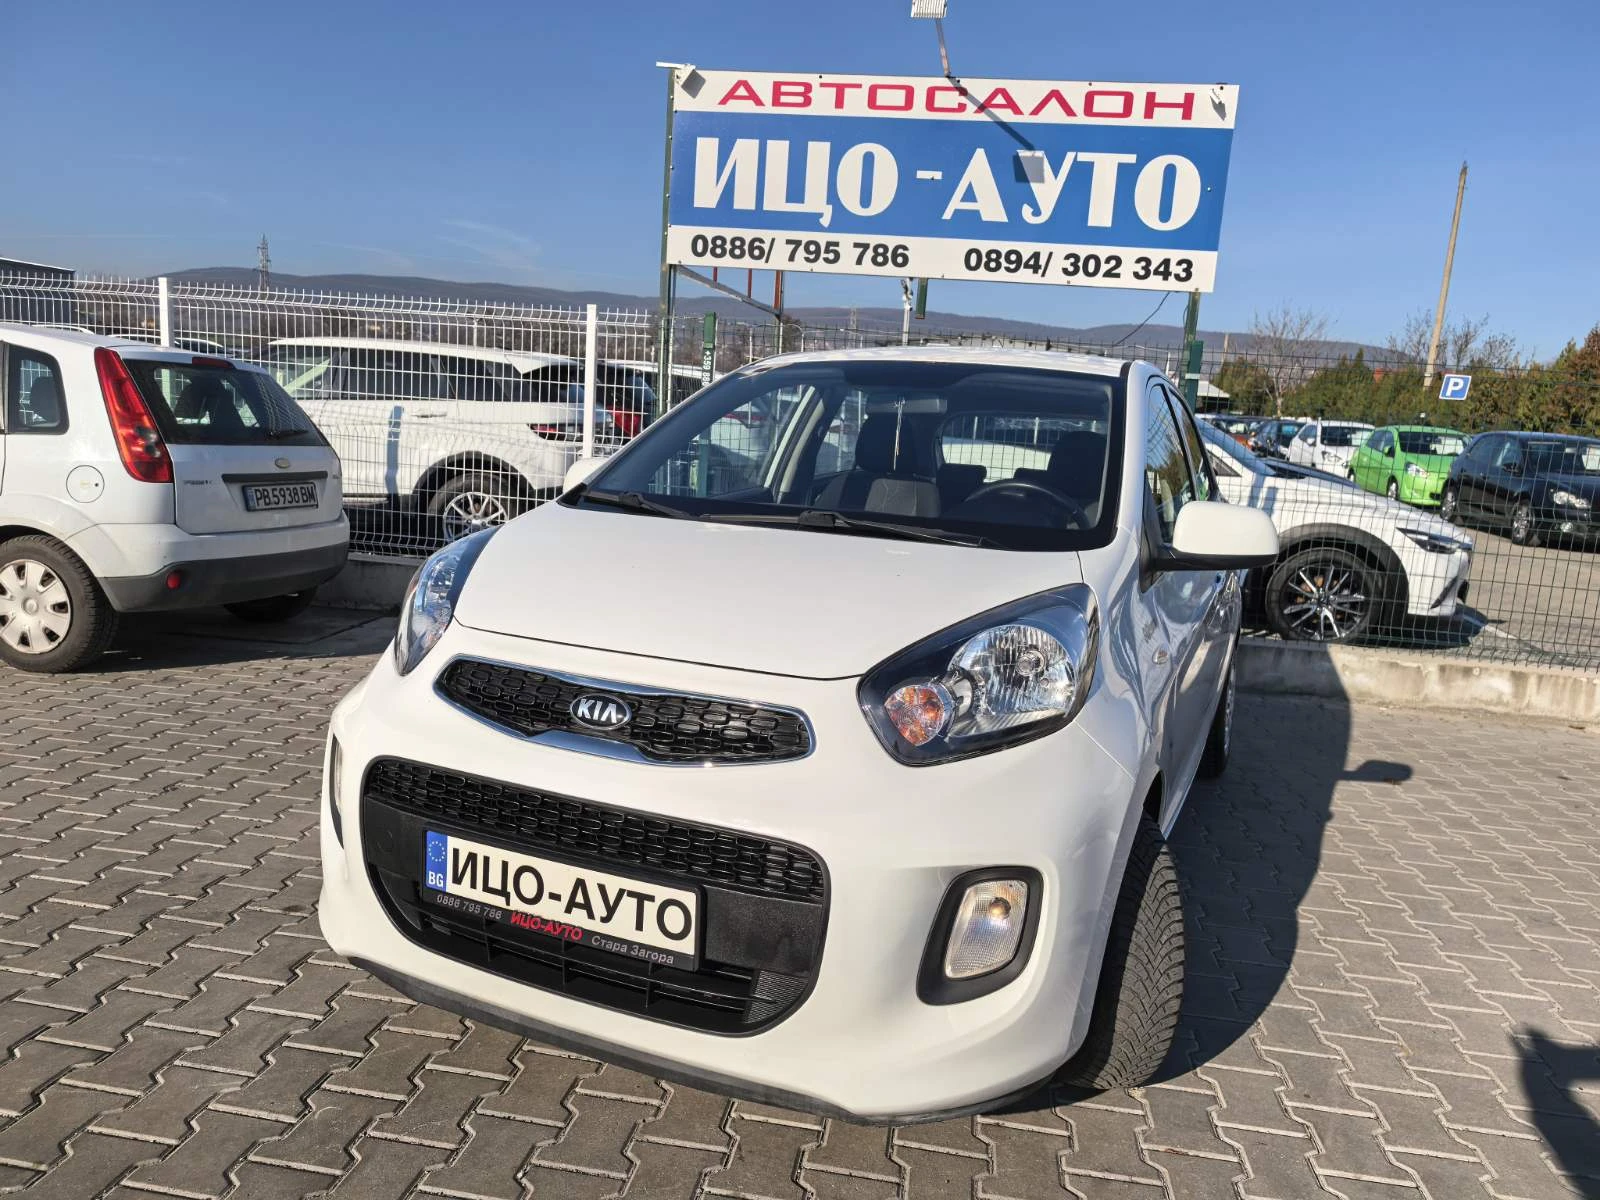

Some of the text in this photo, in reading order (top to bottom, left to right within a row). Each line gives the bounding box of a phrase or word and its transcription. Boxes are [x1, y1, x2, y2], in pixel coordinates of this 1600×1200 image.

[719, 79, 1195, 121] АВТОСАЛОН
[691, 234, 910, 268] 0886/ 795 786
[964, 247, 1195, 283] 0894/ 302 343
[1445, 377, 1464, 397] P
[577, 698, 618, 724] KIA
[428, 870, 444, 888] BG
[451, 847, 692, 941] ИЦО-АУТО
[436, 894, 502, 920] 0886 795 786
[510, 911, 584, 941] ИЦО-АУТО
[591, 934, 675, 965] Стара Загора
